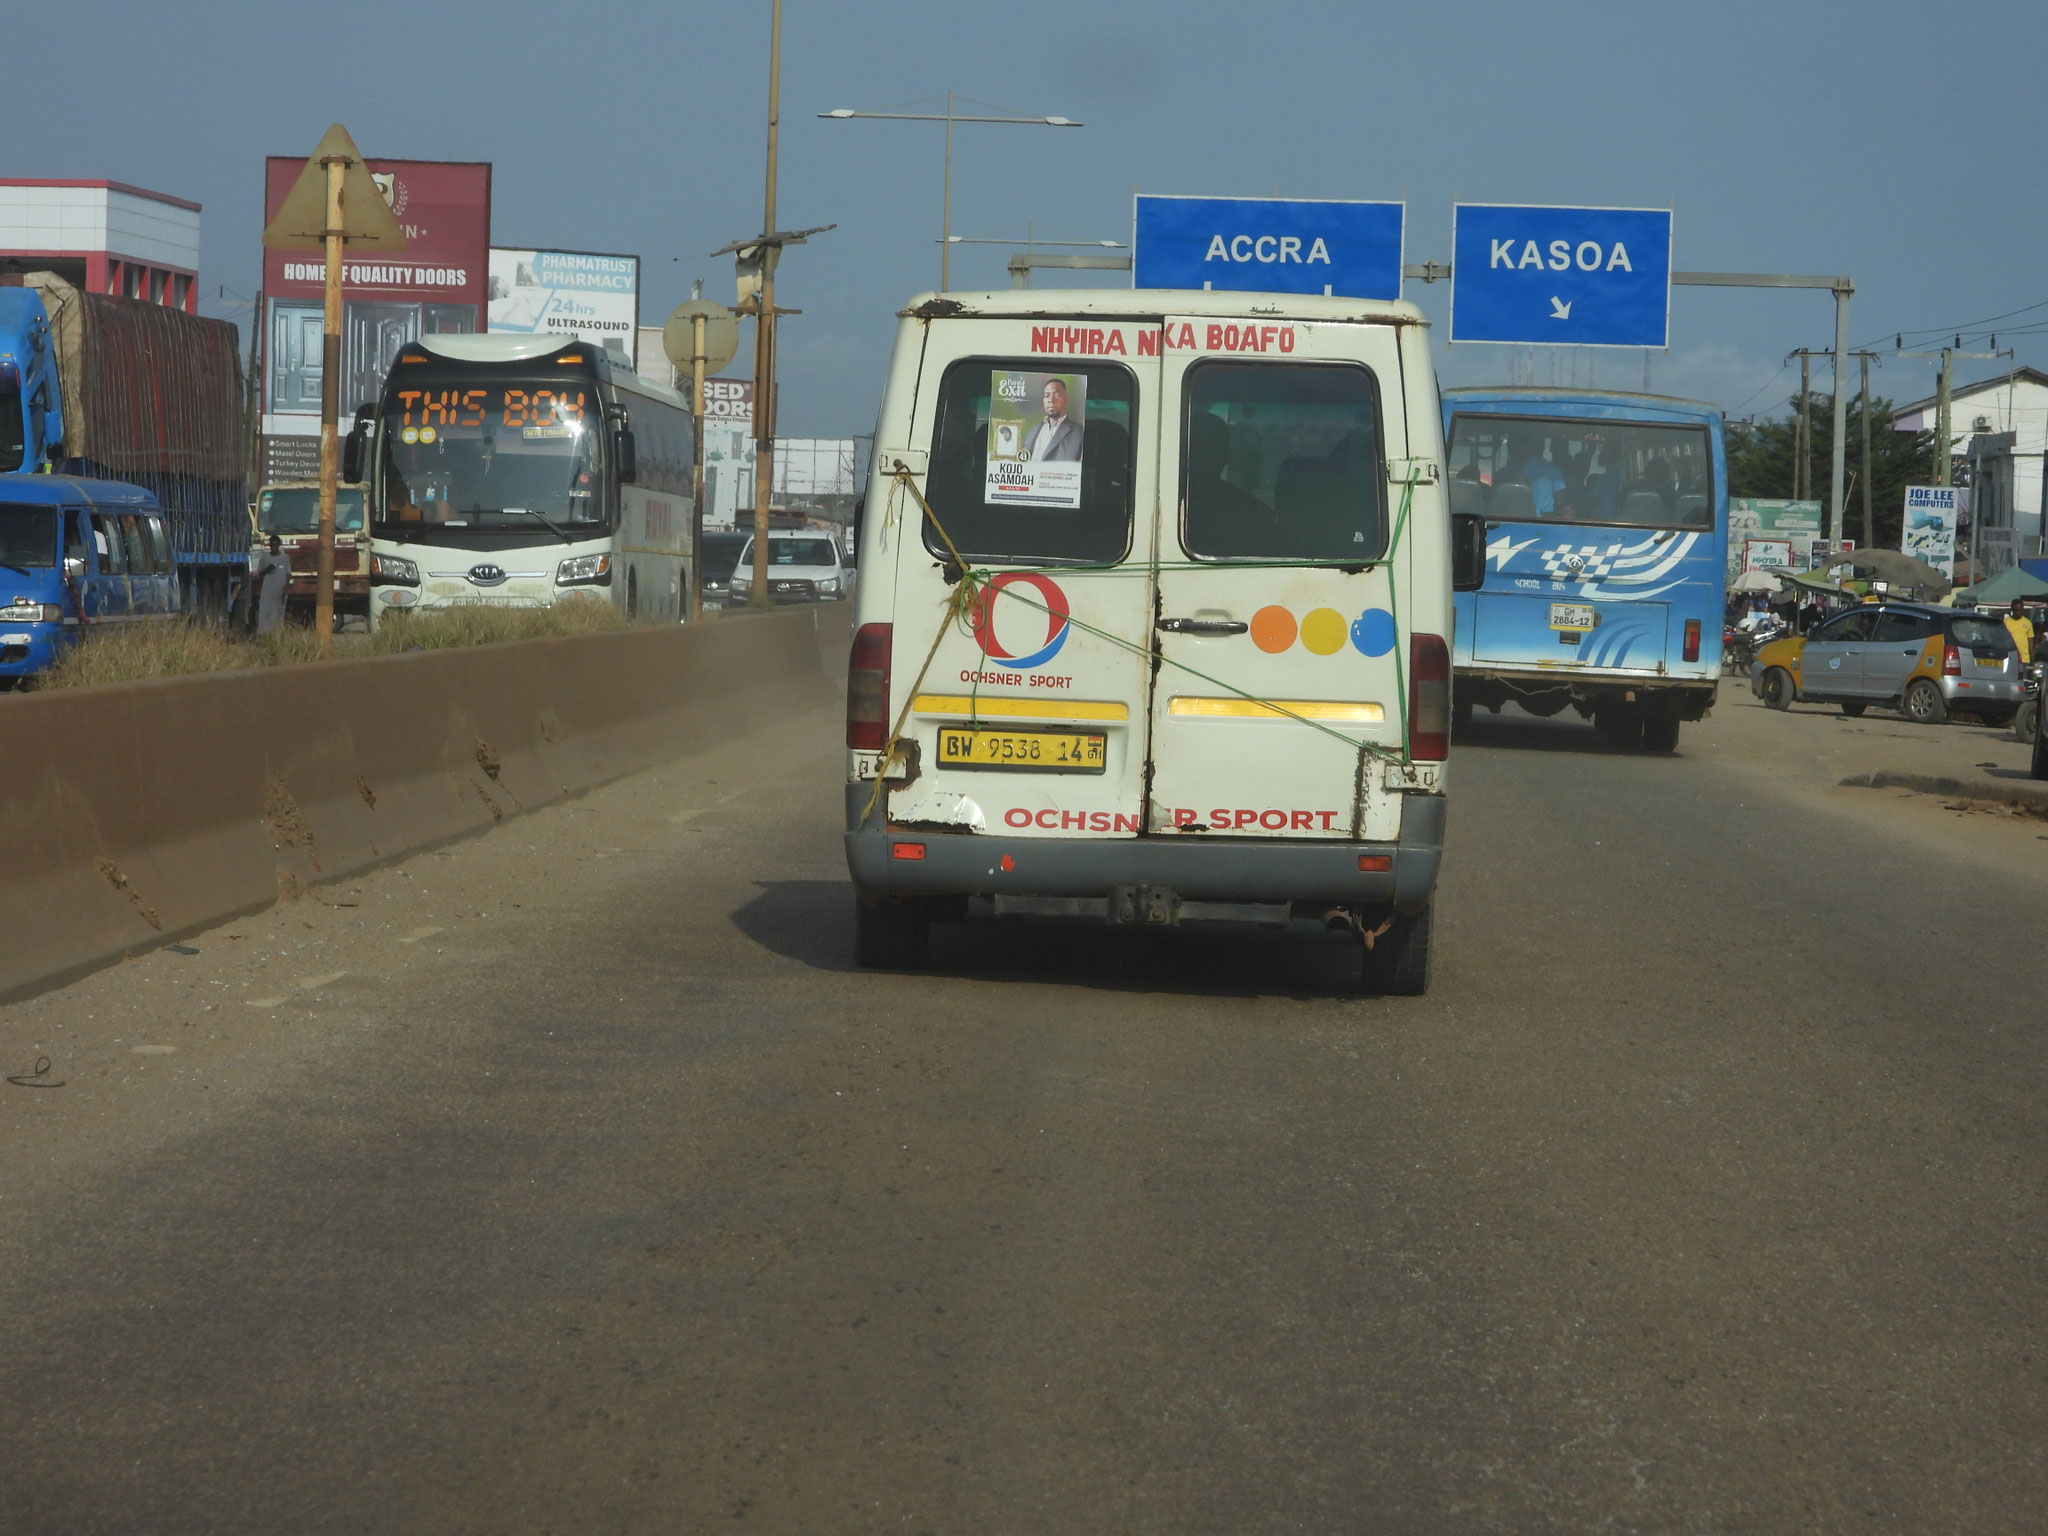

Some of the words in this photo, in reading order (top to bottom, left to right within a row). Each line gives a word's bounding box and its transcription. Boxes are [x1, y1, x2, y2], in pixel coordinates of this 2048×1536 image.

[1204, 234, 1331, 265] ACCRA
[1491, 238, 1633, 273] KASOA
[542, 254, 634, 273] PHARMATRUST
[284, 263, 325, 281] HOME
[350, 266, 413, 285] QUALITY
[415, 268, 467, 286] DOORS
[542, 271, 633, 289] PHARMACY
[547, 318, 630, 331] ULTRASOUND
[1031, 325, 1127, 356] NHYIRA
[1206, 324, 1295, 353] BOAFO
[398, 390, 488, 426] THIS
[275, 440, 295, 448] Smart
[275, 460, 298, 468] Turkey
[1000, 463, 1023, 474] KOJO
[987, 473, 1034, 485] ASAMOAH
[1909, 488, 1931, 500] JOE
[1934, 490, 1954, 500] LEE
[1908, 499, 1954, 509] COMPUTERS
[475, 566, 504, 577] KIA
[1515, 579, 1541, 589] SCHOOL
[1552, 581, 1566, 591] BUS
[960, 670, 1022, 686] OCHSNER
[1029, 675, 1073, 689] SPORT
[989, 738, 1041, 760] 9538
[1057, 737, 1083, 762] 14
[1003, 808, 1199, 833] OCHSNR
[1209, 808, 1338, 831] SPORT
